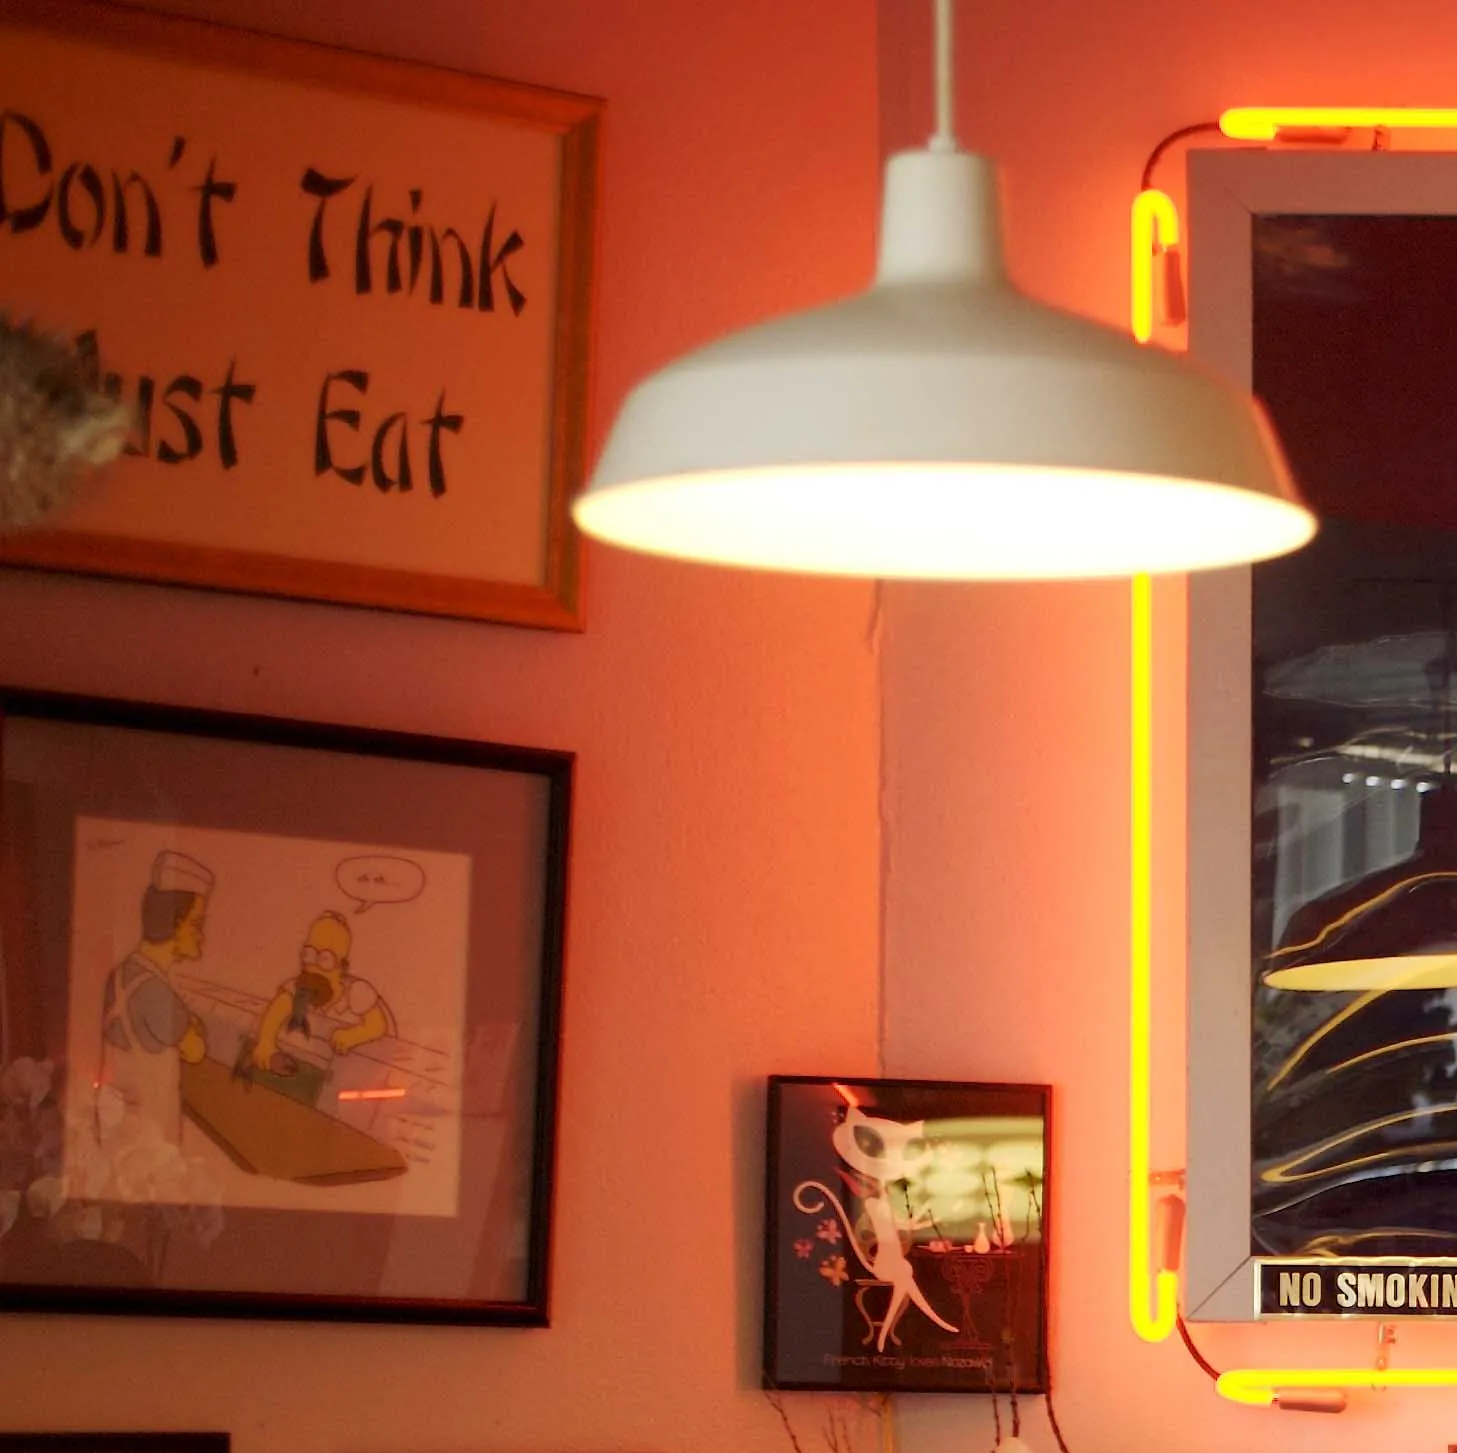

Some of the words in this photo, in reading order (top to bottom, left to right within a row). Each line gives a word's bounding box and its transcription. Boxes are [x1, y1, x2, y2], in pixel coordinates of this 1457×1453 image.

[0, 111, 237, 269] Don't
[299, 167, 527, 318] Think
[75, 328, 257, 470] ust
[314, 369, 465, 500] Eat
[1279, 1272, 1322, 1307] NO
